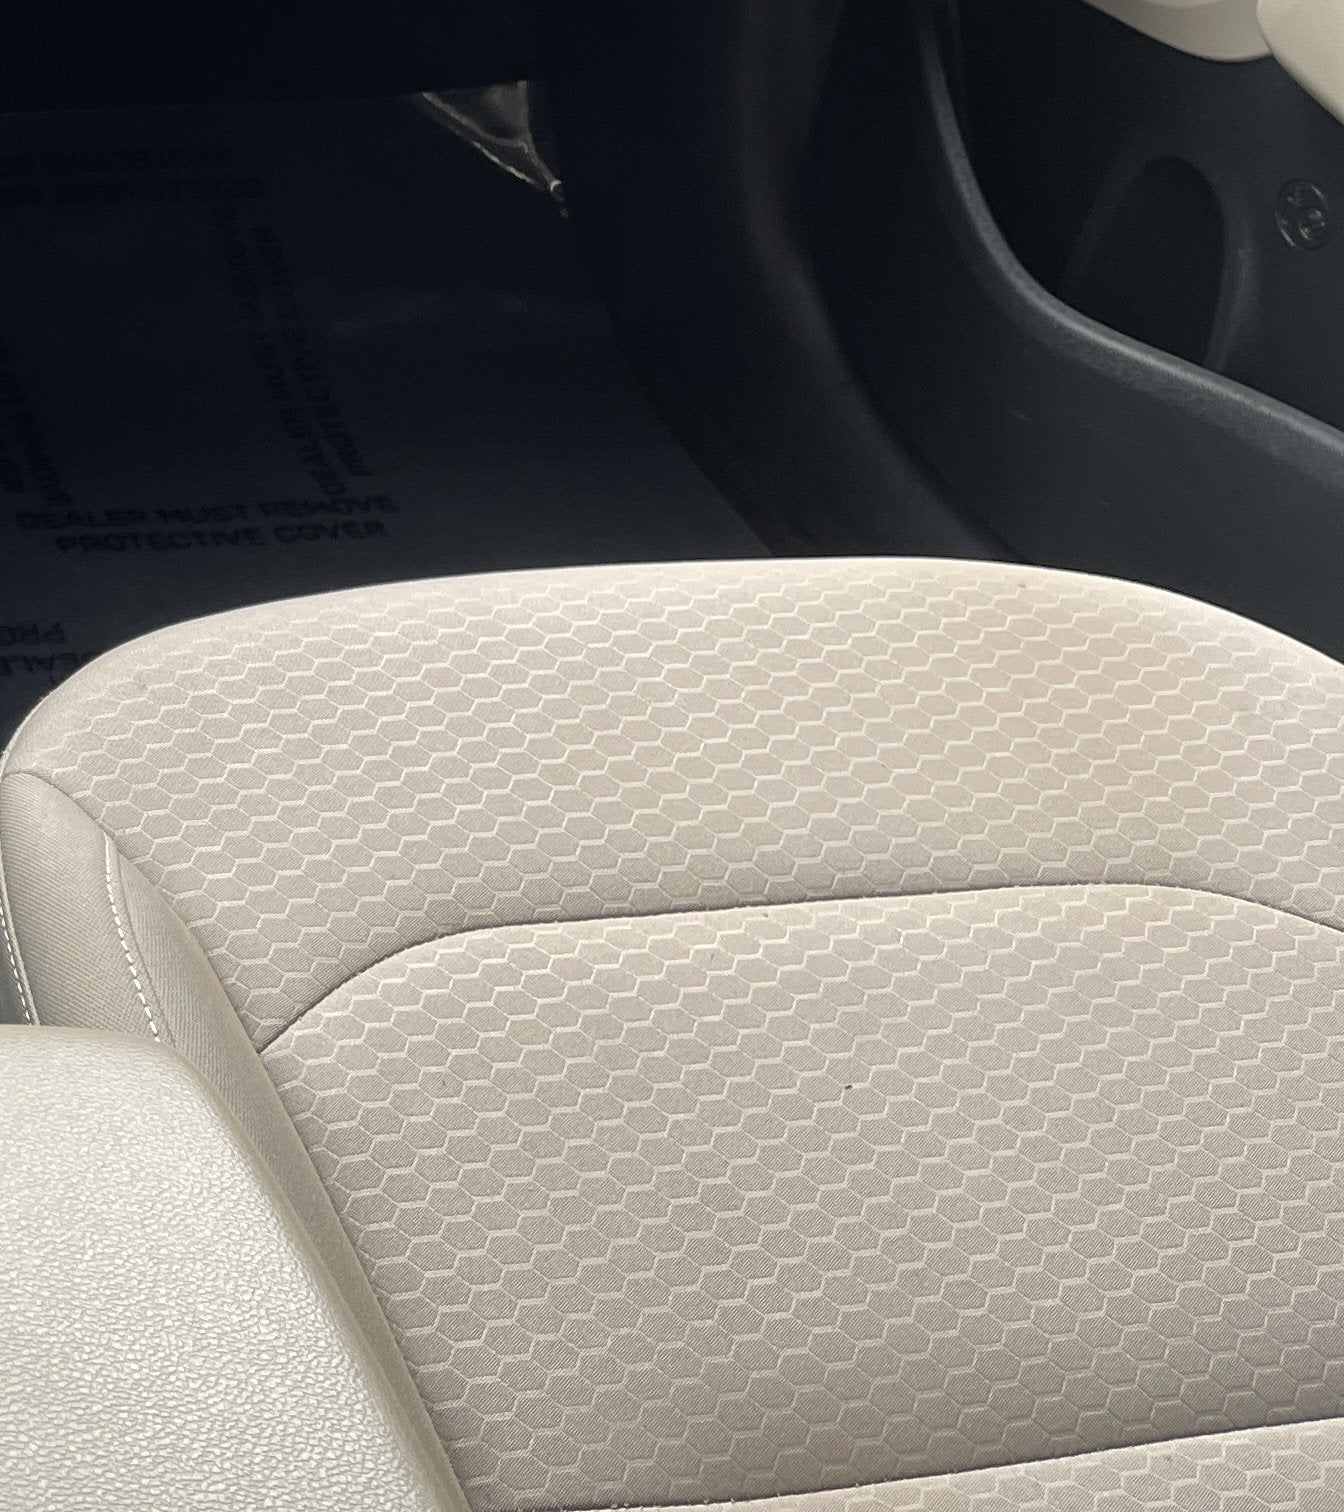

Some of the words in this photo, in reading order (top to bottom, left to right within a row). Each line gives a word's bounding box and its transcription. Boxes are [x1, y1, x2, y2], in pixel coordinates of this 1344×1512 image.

[15, 506, 149, 530] DEALER
[155, 503, 249, 524] MUST
[258, 494, 398, 518] REMOVE
[54, 527, 266, 554] PROTECTIVE
[277, 520, 388, 543] COVER
